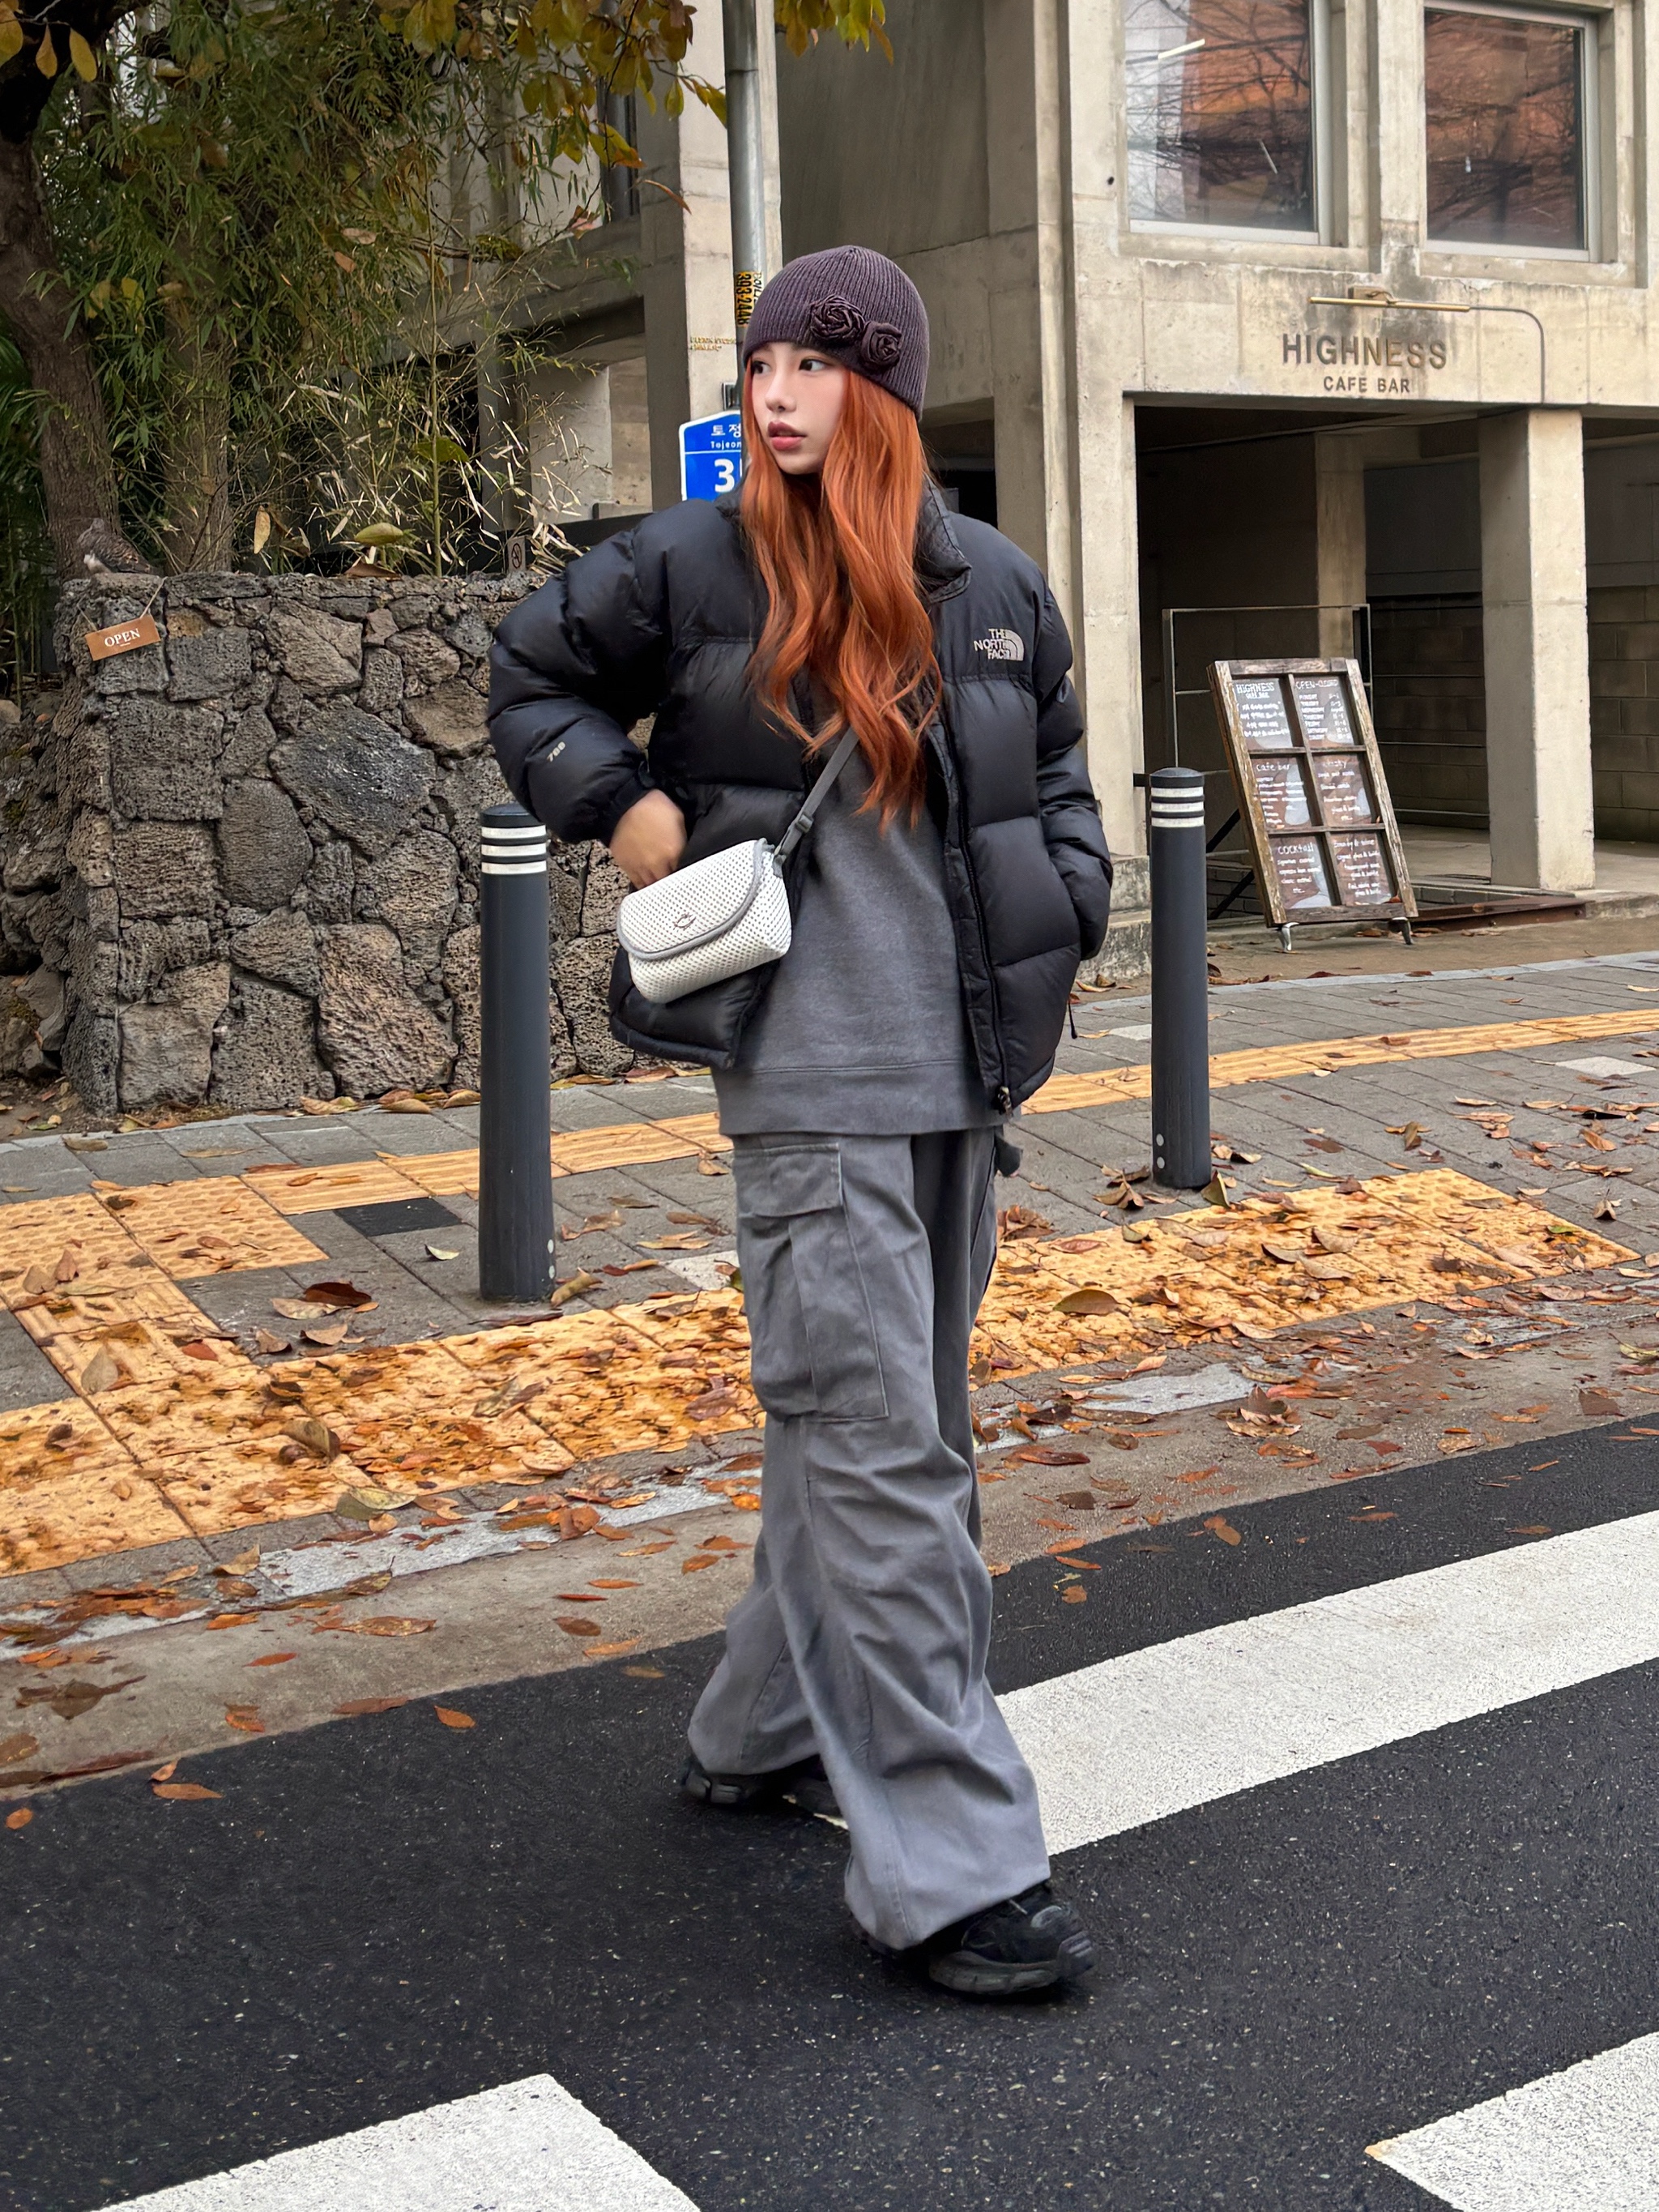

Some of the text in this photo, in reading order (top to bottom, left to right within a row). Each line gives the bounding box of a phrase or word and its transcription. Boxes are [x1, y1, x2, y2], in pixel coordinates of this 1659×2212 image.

[1282, 333, 1447, 369] HIGHNESS
[1323, 375, 1410, 393] CAFE BAR
[104, 628, 141, 647] OPEN
[987, 628, 1007, 639] THE
[987, 649, 1010, 660] FACE
